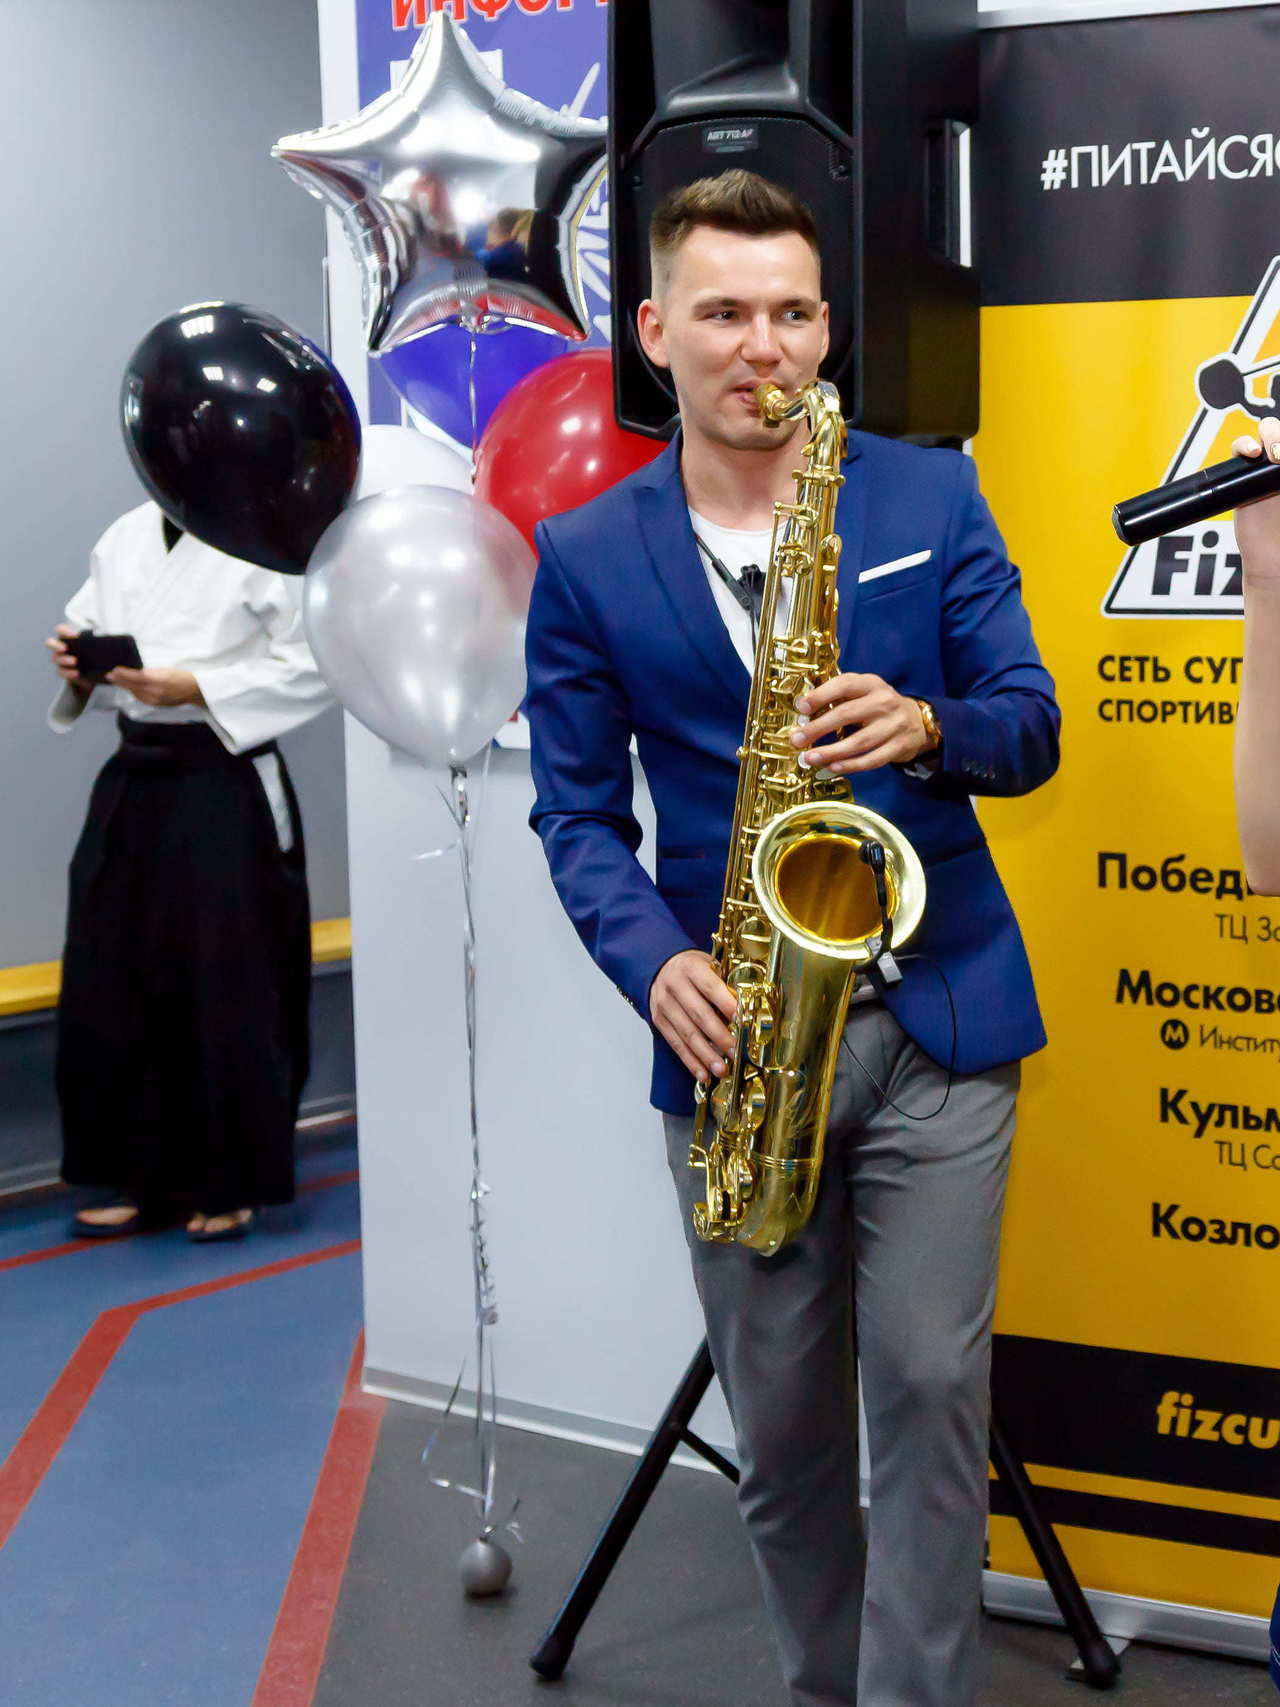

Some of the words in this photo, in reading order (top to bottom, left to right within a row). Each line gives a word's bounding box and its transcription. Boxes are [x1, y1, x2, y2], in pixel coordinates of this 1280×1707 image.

[1098, 655, 1170, 683] СЕТЬ
[1215, 913, 1248, 945] ТЦ
[1214, 1140, 1247, 1171] ТЦ
